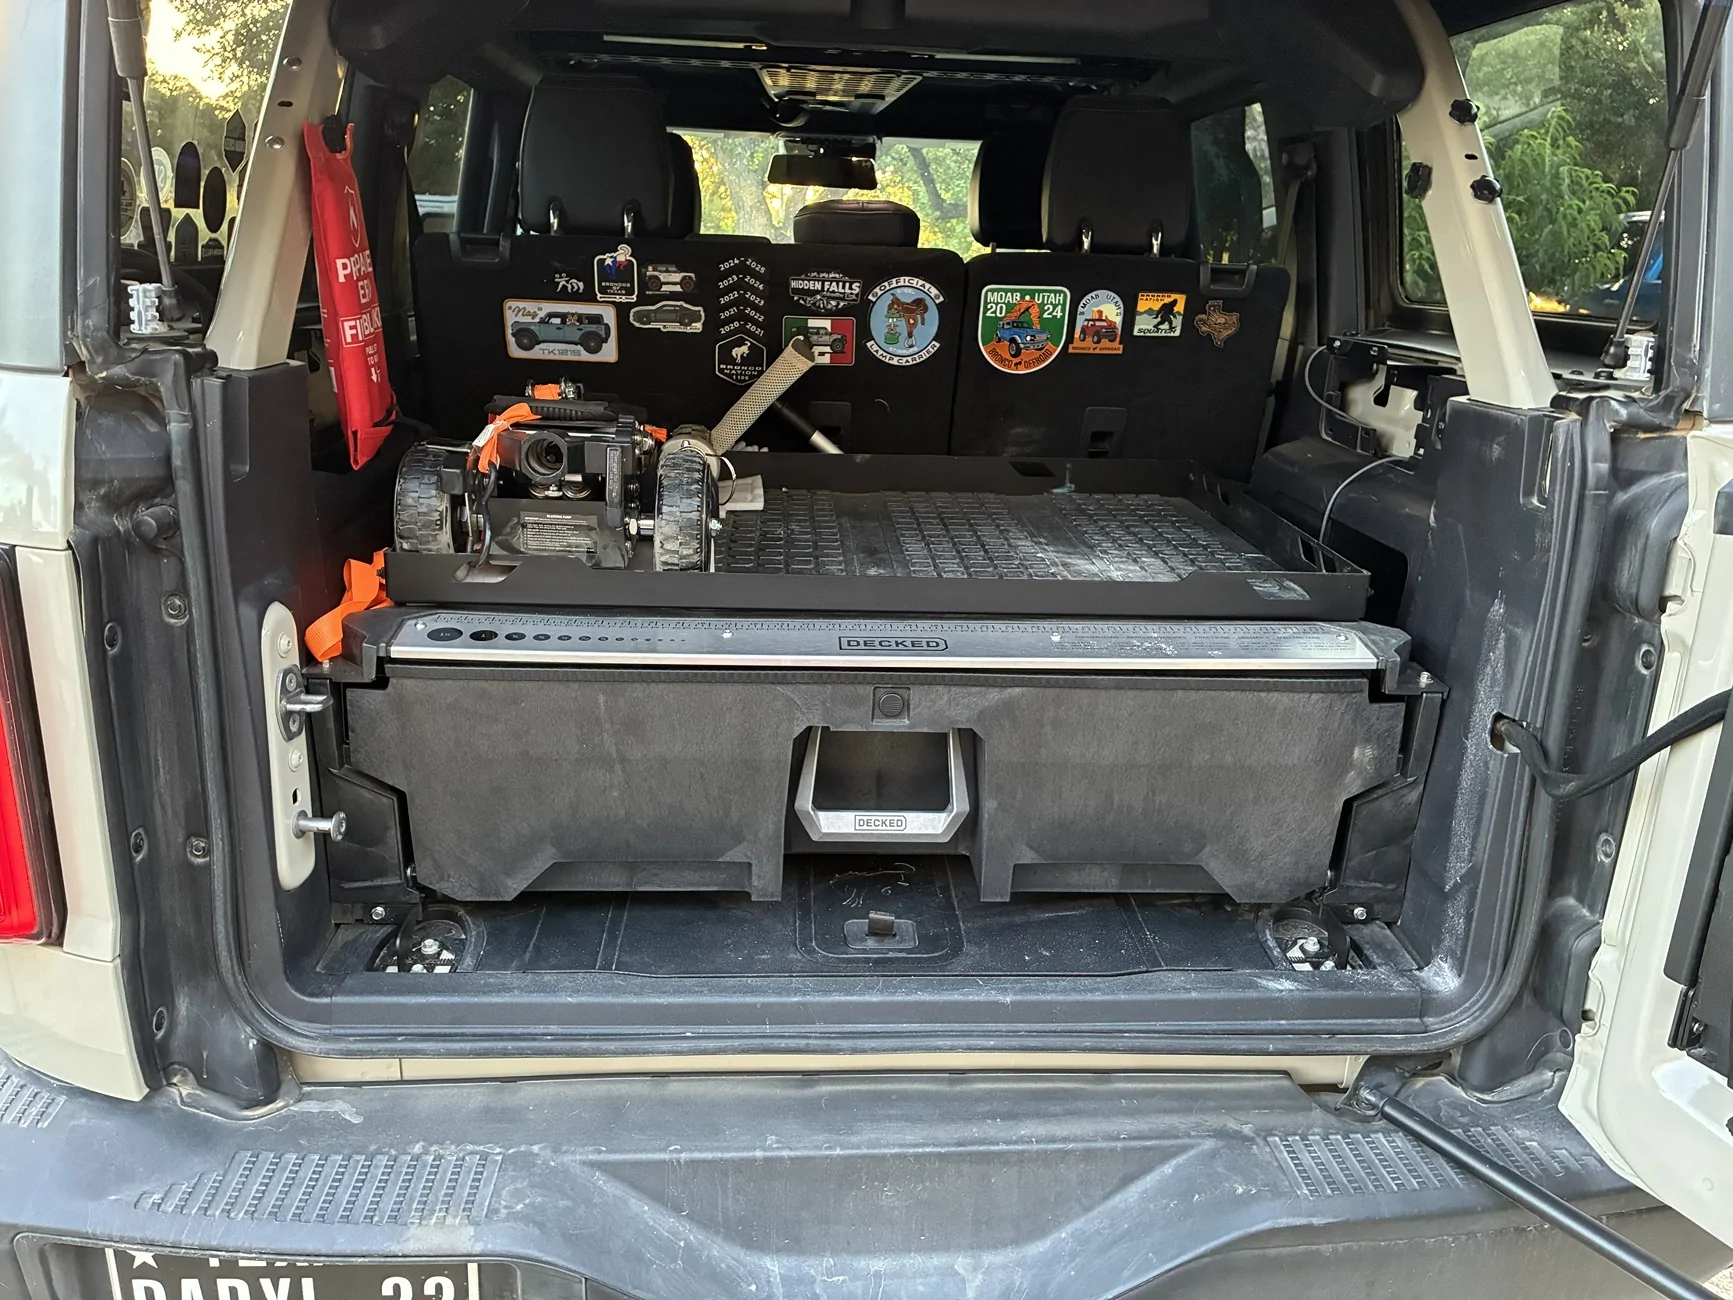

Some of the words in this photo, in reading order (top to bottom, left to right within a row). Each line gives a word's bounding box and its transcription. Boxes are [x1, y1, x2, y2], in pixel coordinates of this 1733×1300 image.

[718, 258, 740, 270] 2024
[746, 258, 766, 273] 2025
[718, 274, 738, 288] 2023
[744, 275, 764, 290] 2024
[791, 280, 822, 291] HIDDEN
[824, 281, 861, 294] FALLS
[879, 278, 932, 294] OFFICIAL
[719, 291, 739, 304] 2022
[744, 291, 764, 306] 2023
[987, 292, 1020, 303] MOAB
[1034, 293, 1064, 304] UTAH
[1080, 293, 1100, 310] MOAB
[1105, 294, 1122, 310] UTAH
[719, 306, 738, 319] 2021
[744, 307, 764, 322] 2022
[986, 303, 1006, 317] 20
[1043, 305, 1063, 318] 24
[719, 321, 740, 334] 2020
[746, 322, 764, 336] 2021
[869, 344, 894, 362] LAMP
[896, 343, 938, 364] CARRIER
[988, 348, 1013, 369] BRONCO
[1024, 348, 1053, 369] OFFROAD
[846, 640, 940, 648] DECKED
[858, 818, 904, 828] DECKED
